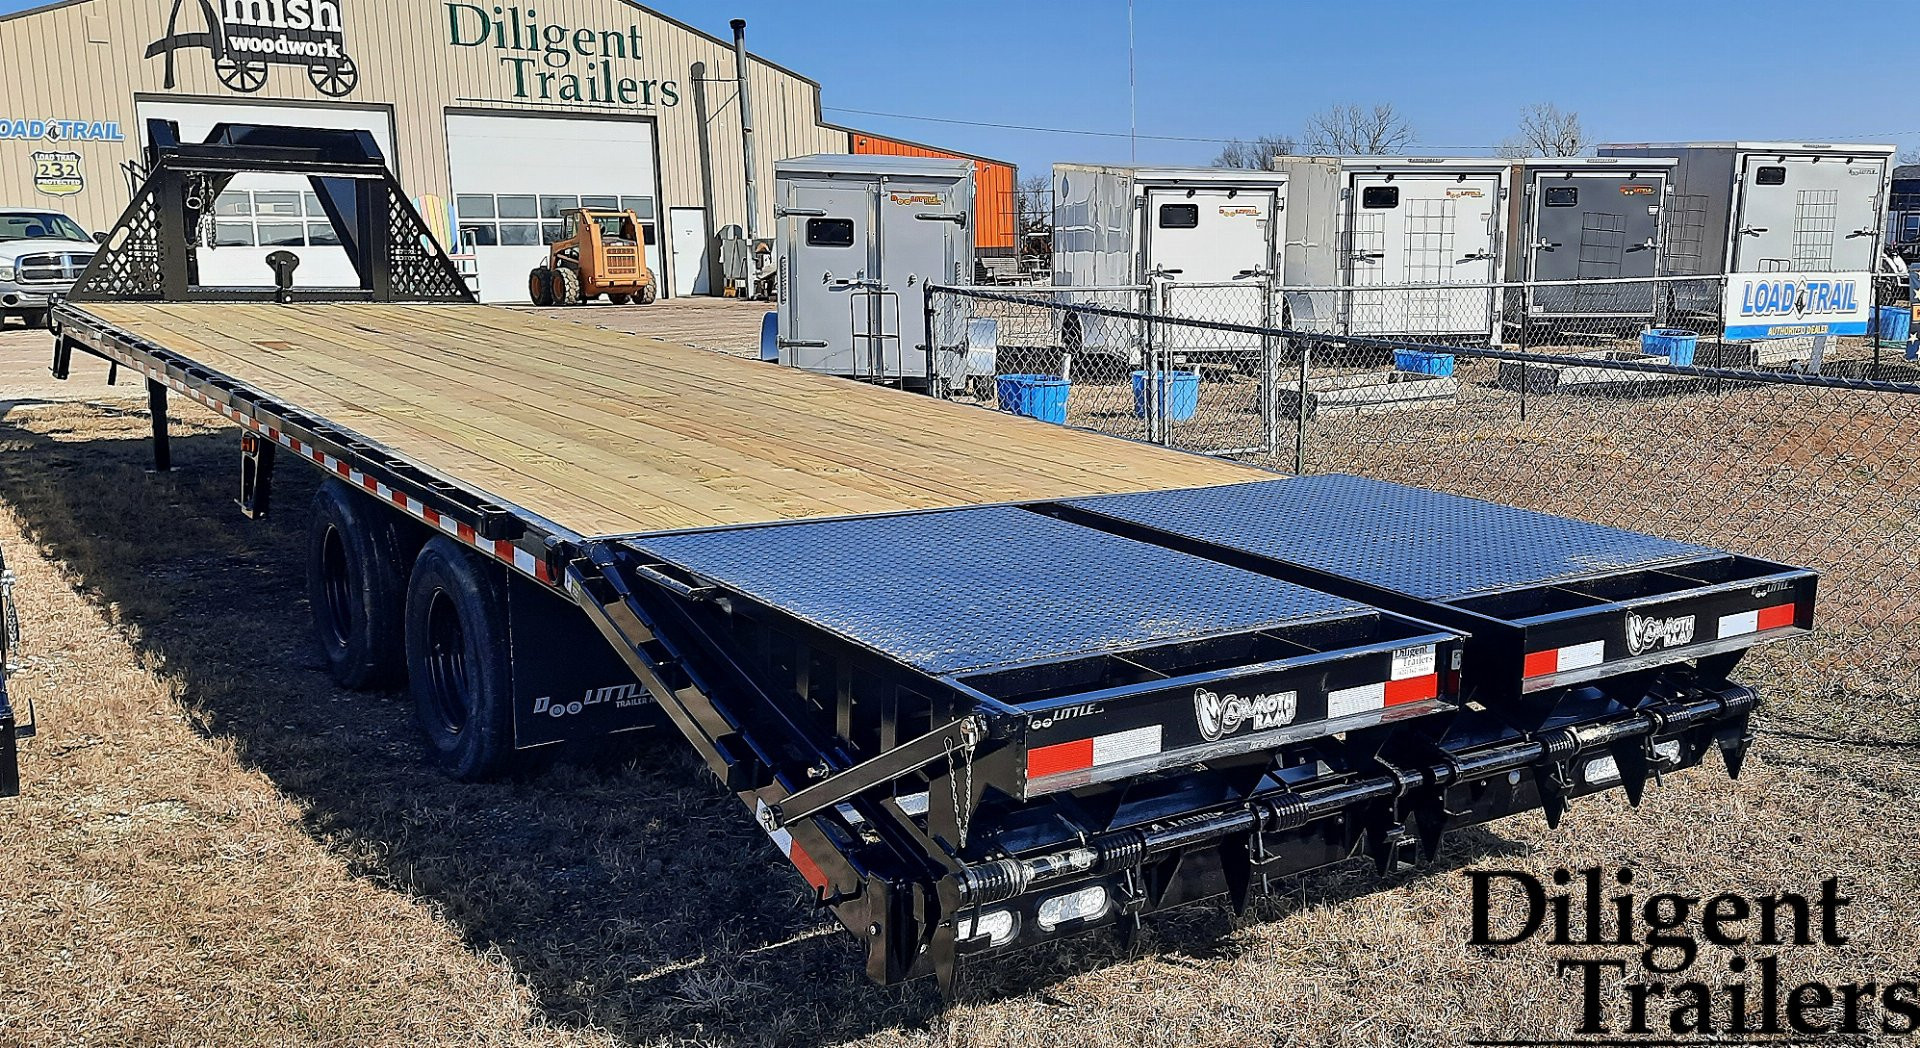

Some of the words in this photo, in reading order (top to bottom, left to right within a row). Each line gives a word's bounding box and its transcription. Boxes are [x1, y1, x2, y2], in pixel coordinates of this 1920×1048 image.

[228, 34, 341, 58] woodwork
[444, 2, 643, 69] Diligent
[500, 56, 680, 108] Trailers
[0, 120, 46, 139] OAD
[58, 121, 125, 140] TRAIL
[40, 162, 76, 178] 232
[1741, 281, 1796, 314] LOAD
[1803, 281, 1858, 312] TRAIL
[1767, 325, 1806, 336] AUTHORIZED
[1806, 325, 1828, 335] DEALER
[615, 698, 647, 709] TRAILER
